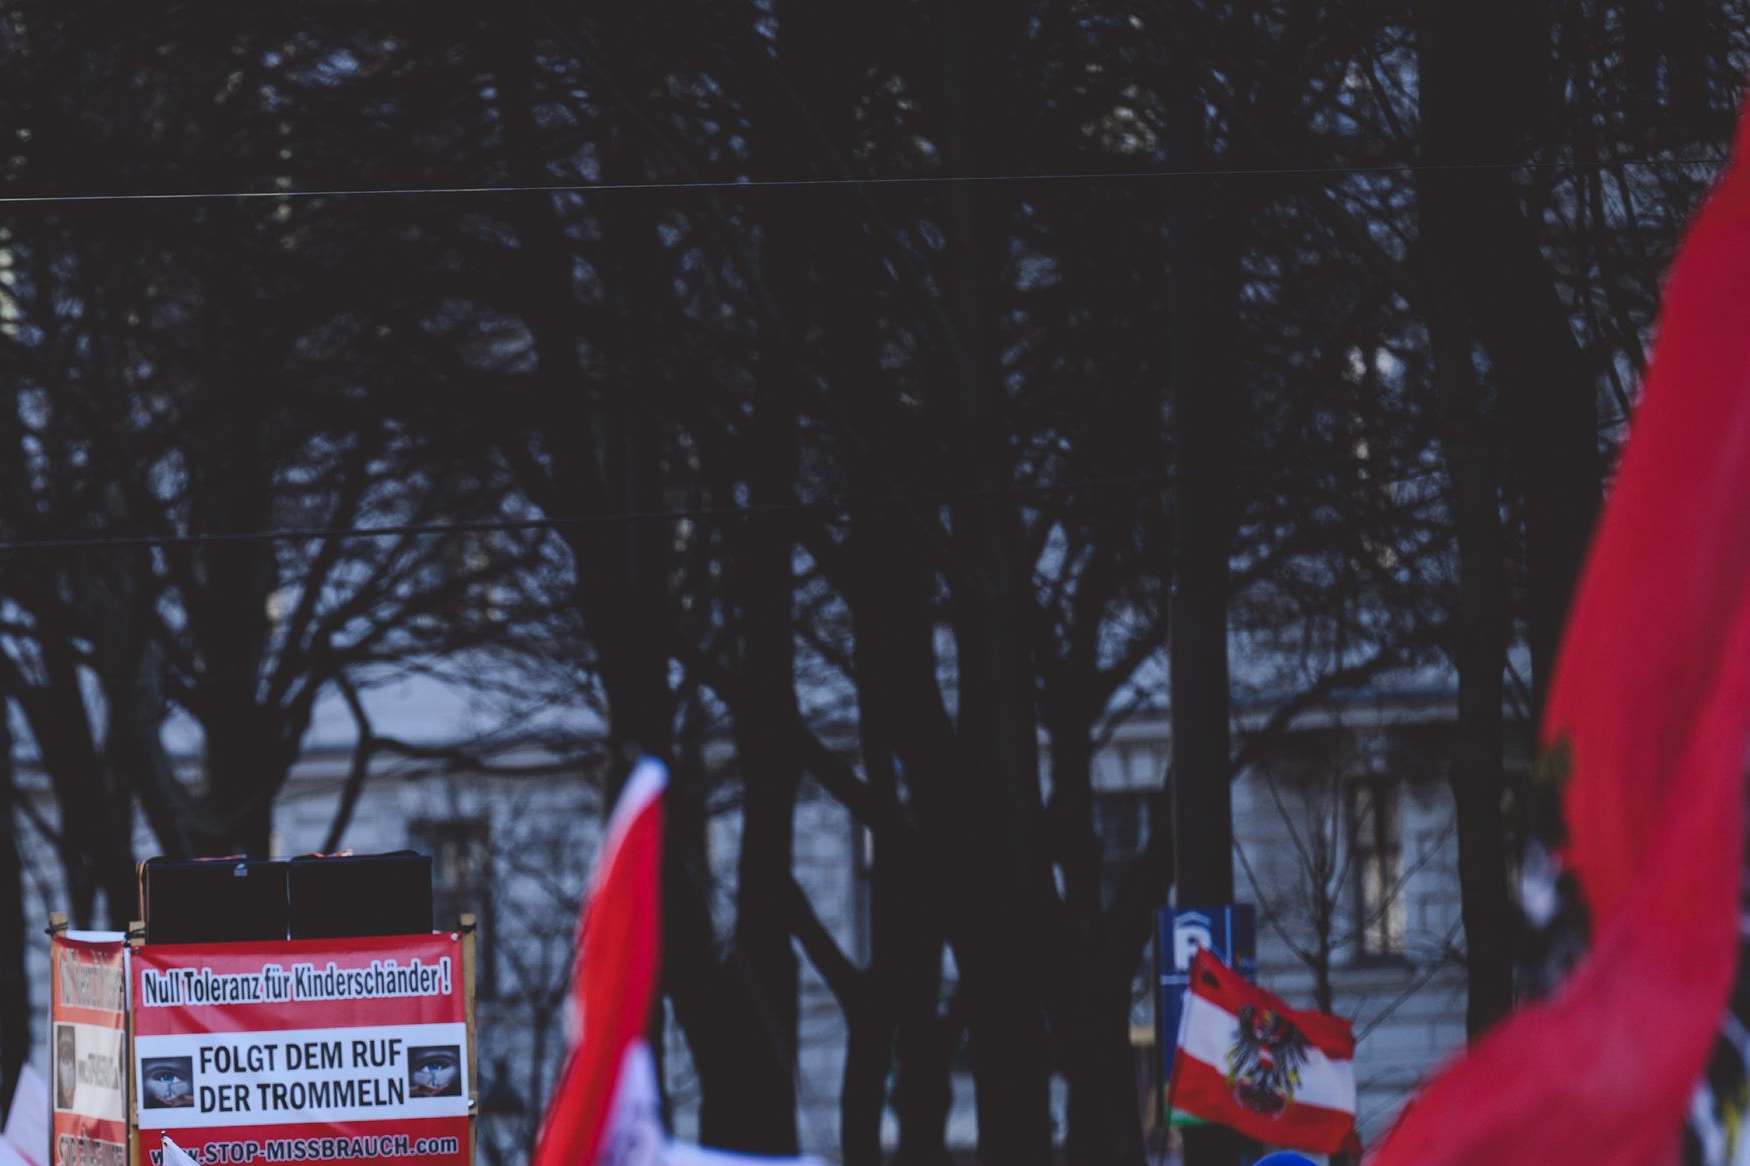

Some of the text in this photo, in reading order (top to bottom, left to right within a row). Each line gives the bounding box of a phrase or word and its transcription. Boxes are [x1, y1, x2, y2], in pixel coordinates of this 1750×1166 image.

[145, 970, 180, 1004] Null
[184, 969, 260, 1003] Toleranz
[264, 966, 290, 999] für
[295, 959, 437, 998] Kinderschänder
[200, 1039, 402, 1074] FOLGT DEM RUF
[200, 1078, 404, 1113] DER TROMMELN
